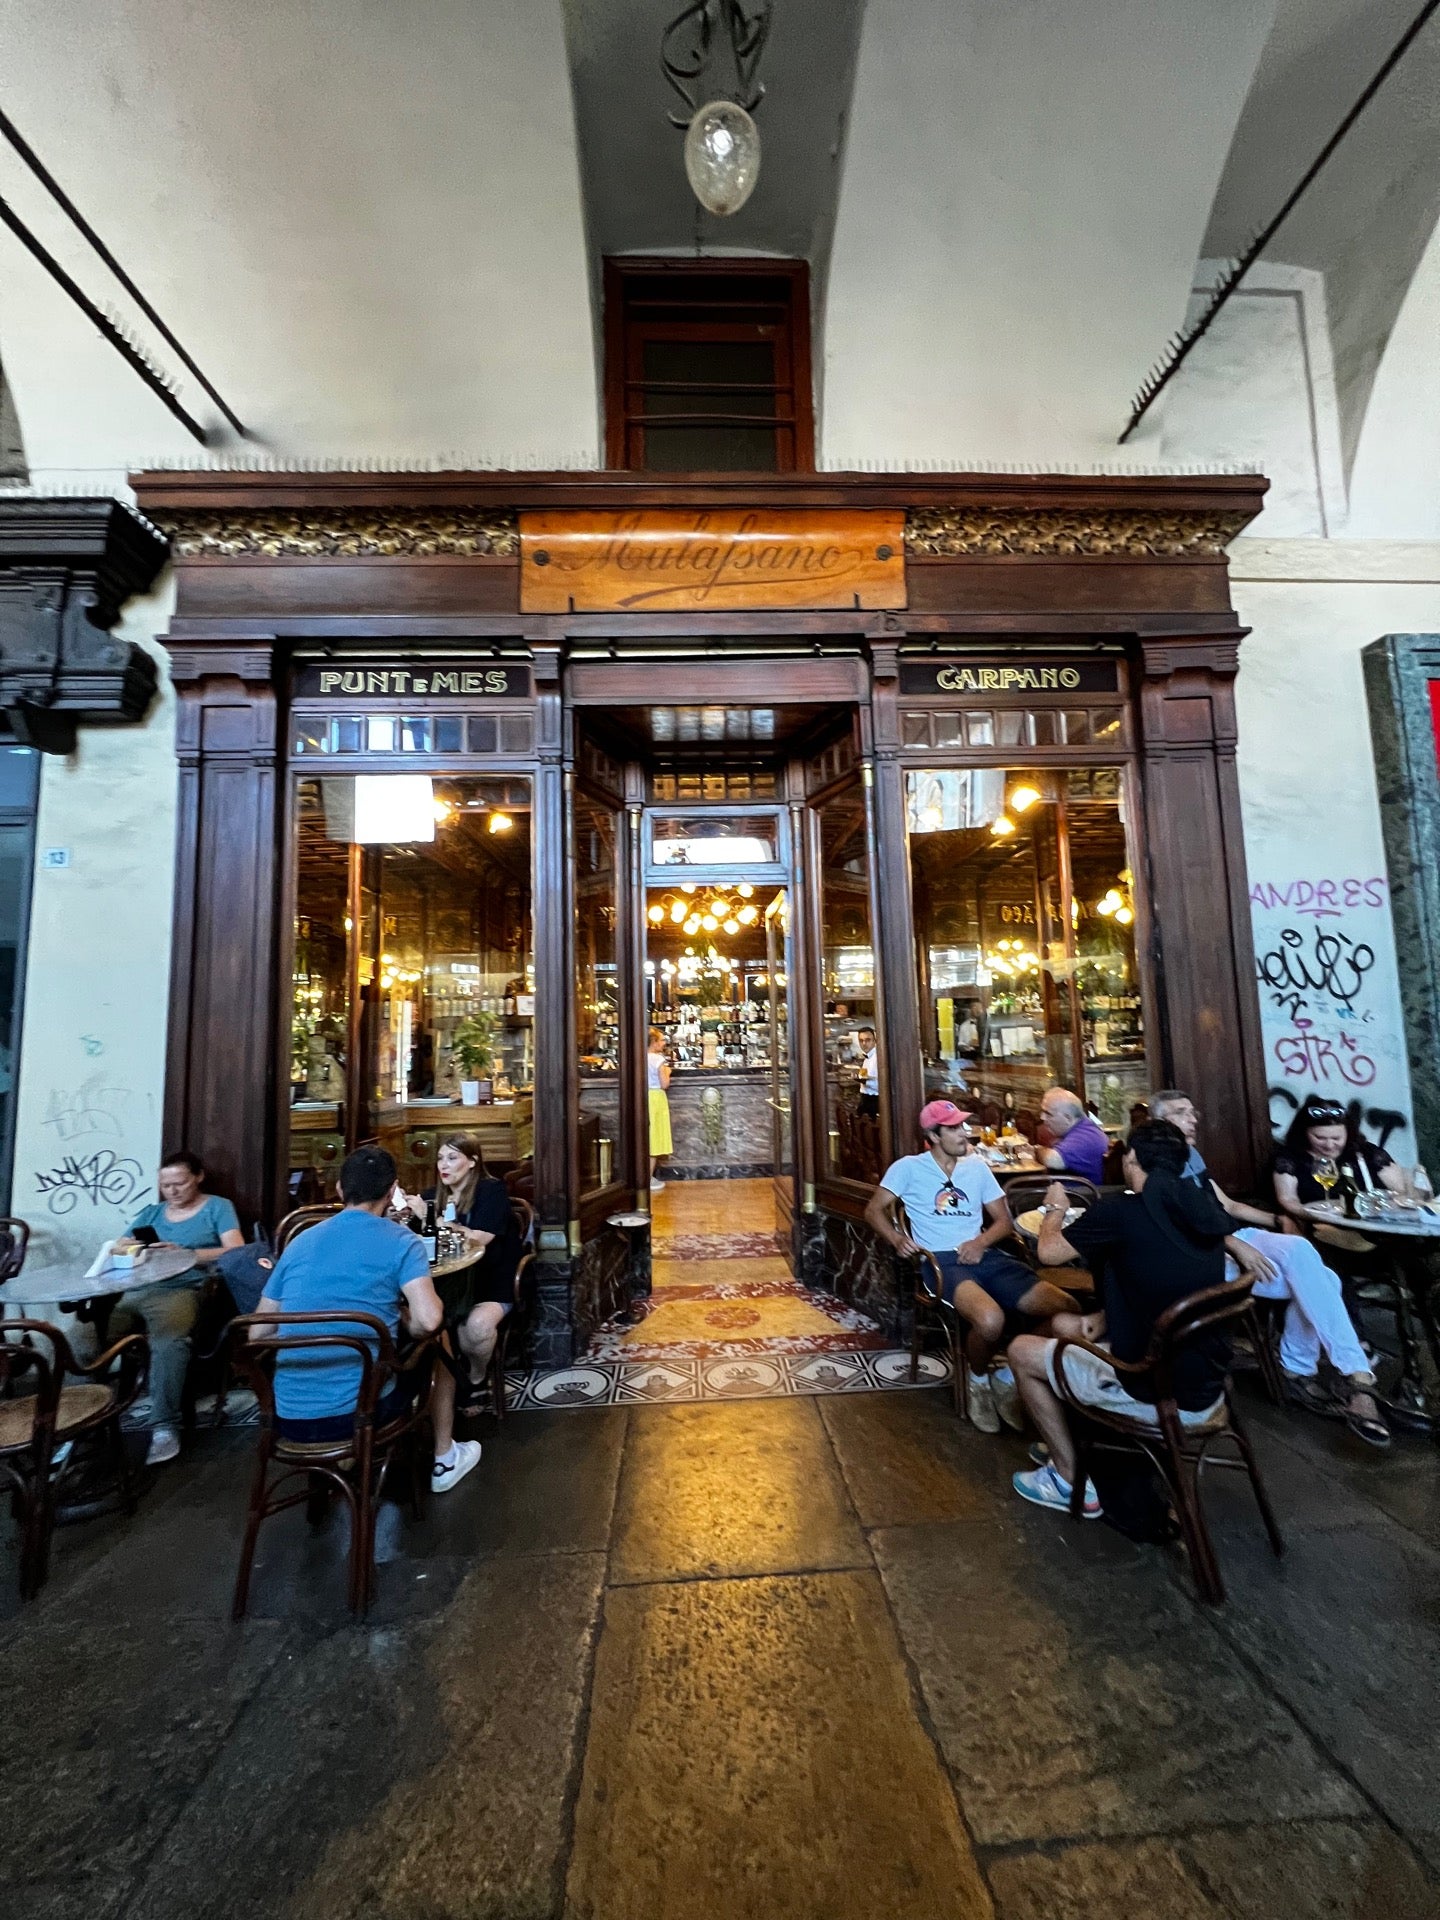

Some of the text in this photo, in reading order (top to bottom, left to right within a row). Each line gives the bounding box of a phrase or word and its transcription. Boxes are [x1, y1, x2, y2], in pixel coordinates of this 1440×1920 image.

[319, 671, 411, 693] PUNT
[430, 670, 508, 693] MES
[936, 667, 1081, 690] CARPANO
[1250, 877, 1388, 909] ANDRES
